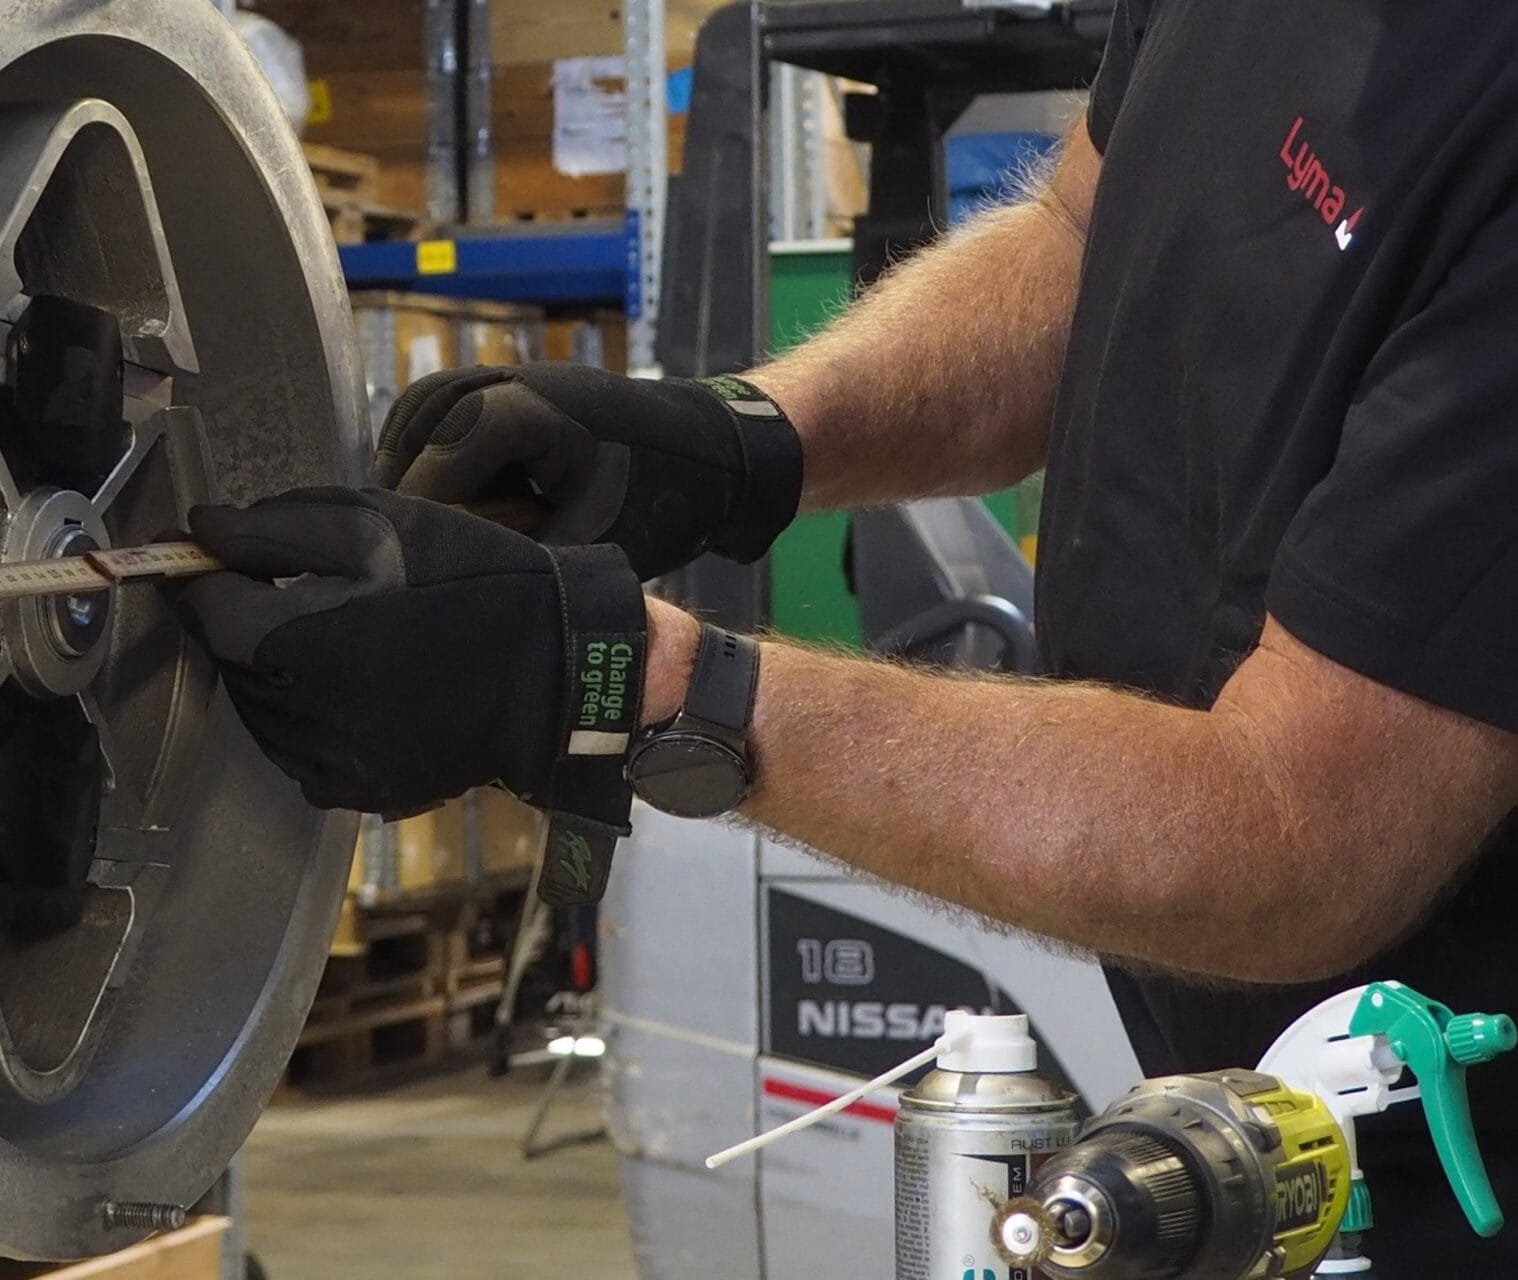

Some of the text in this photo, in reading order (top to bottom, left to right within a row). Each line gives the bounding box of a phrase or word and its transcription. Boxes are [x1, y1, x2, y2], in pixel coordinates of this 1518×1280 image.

[1280, 115, 1346, 225] Lyma
[579, 641, 608, 726] to green
[601, 643, 632, 720] Change
[797, 938, 875, 985] 18
[799, 1000, 994, 1039] NISSA
[1275, 1172, 1317, 1222] RYOBI
